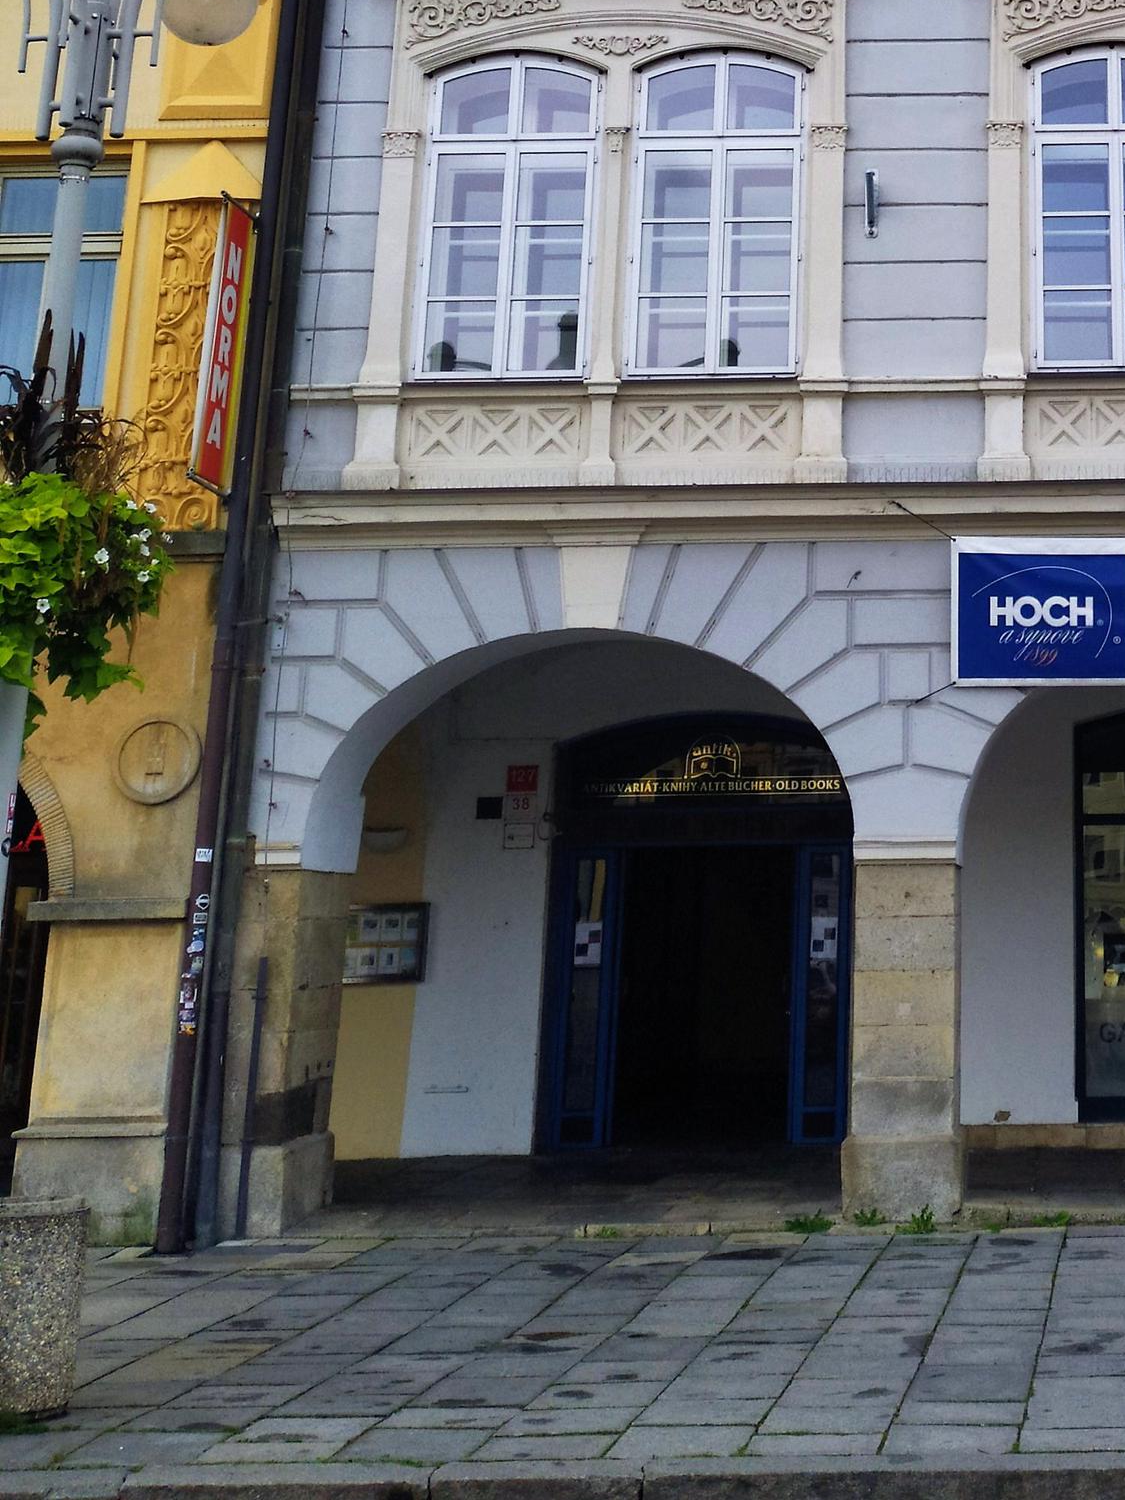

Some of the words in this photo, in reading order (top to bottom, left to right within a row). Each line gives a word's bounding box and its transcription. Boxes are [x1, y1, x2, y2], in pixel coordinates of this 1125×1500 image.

[206, 241, 243, 449] NORMA
[989, 595, 1094, 627] HOCH
[700, 781, 727, 792] ALTE
[776, 780, 799, 791] OLD
[801, 779, 841, 791] BOOKS
[512, 797, 530, 811] 38
